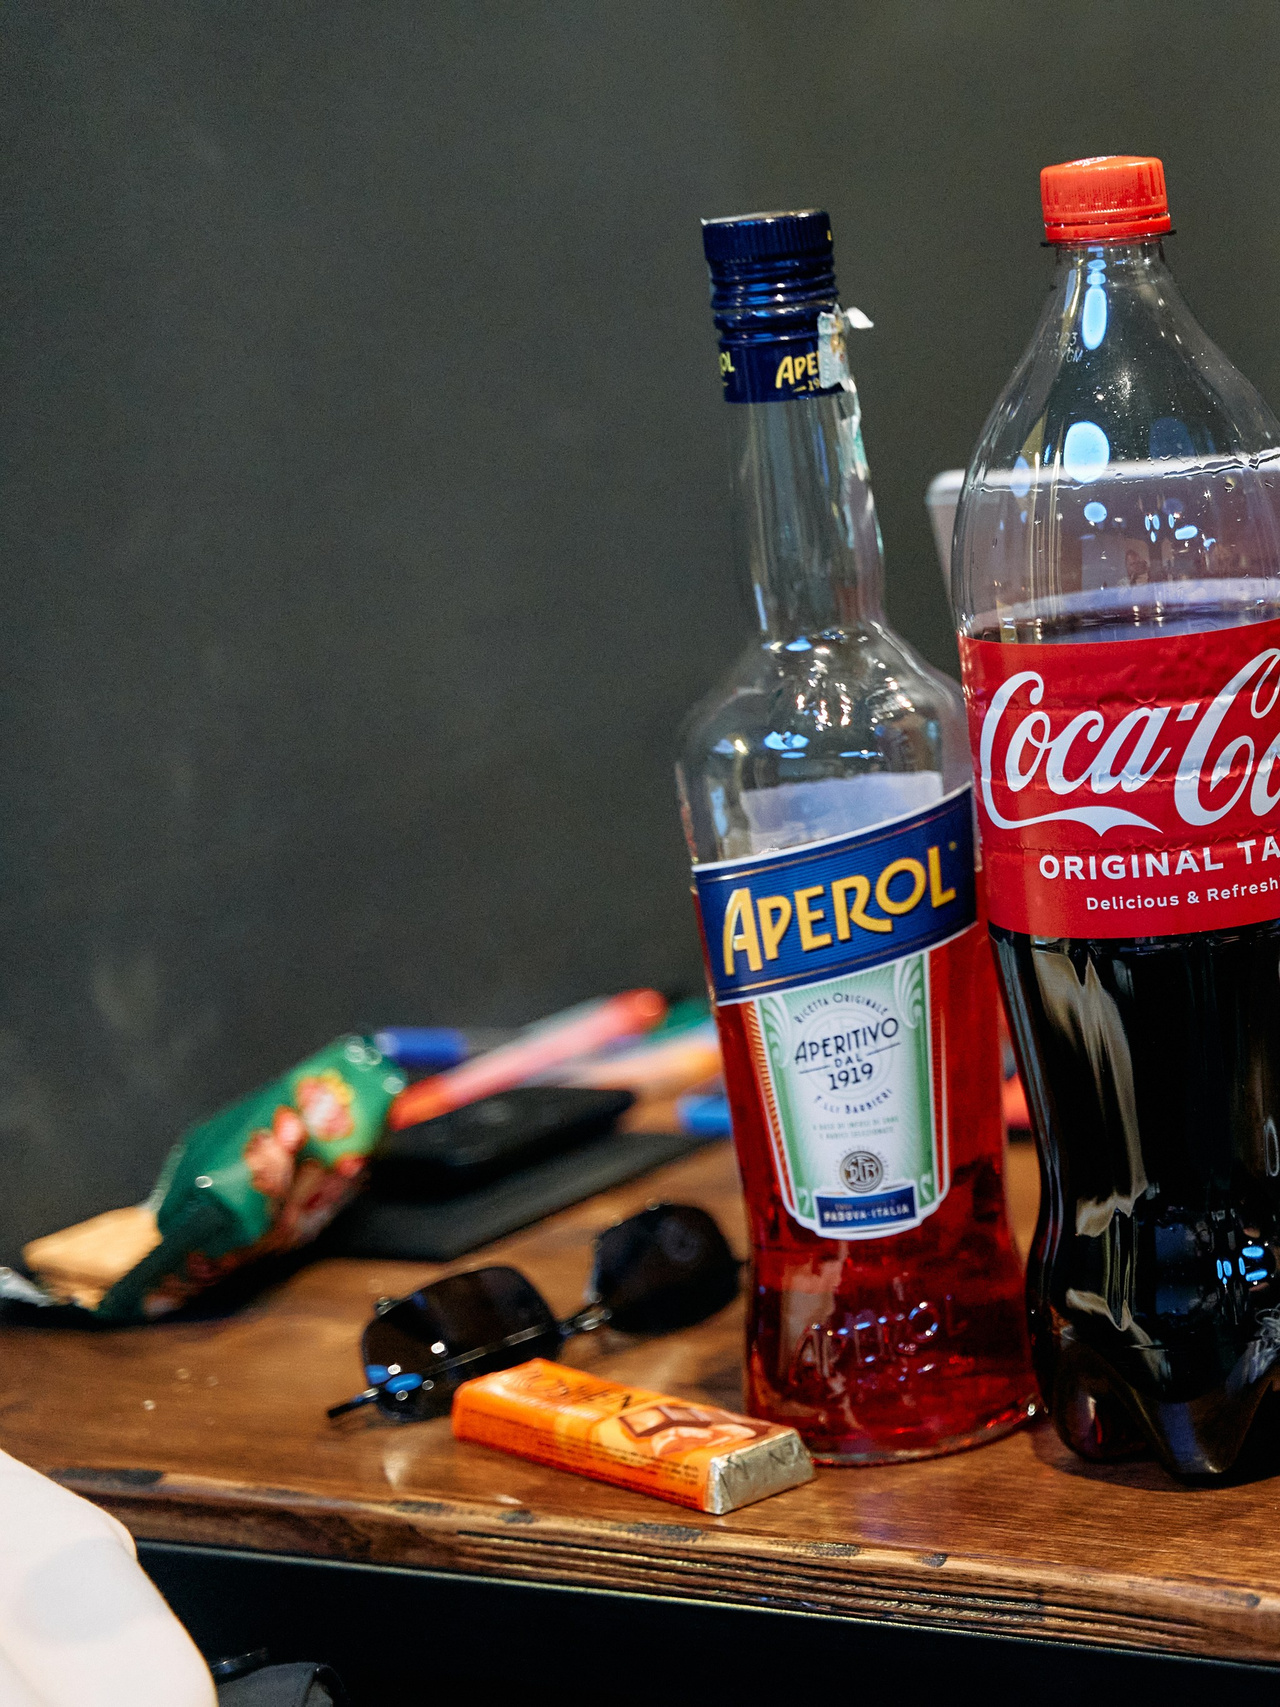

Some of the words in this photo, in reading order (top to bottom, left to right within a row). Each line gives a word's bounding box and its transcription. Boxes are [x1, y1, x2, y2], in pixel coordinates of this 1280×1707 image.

[775, 351, 819, 389] APE
[1039, 848, 1224, 880] ORIGINAL
[723, 846, 957, 977] APEROL
[1086, 895, 1180, 911] Delicious
[1187, 891, 1200, 904] &
[794, 998, 829, 1023] RICETTA
[795, 1017, 899, 1064] APERITIVO
[834, 1053, 864, 1068] DAL
[827, 1062, 874, 1091] 1919
